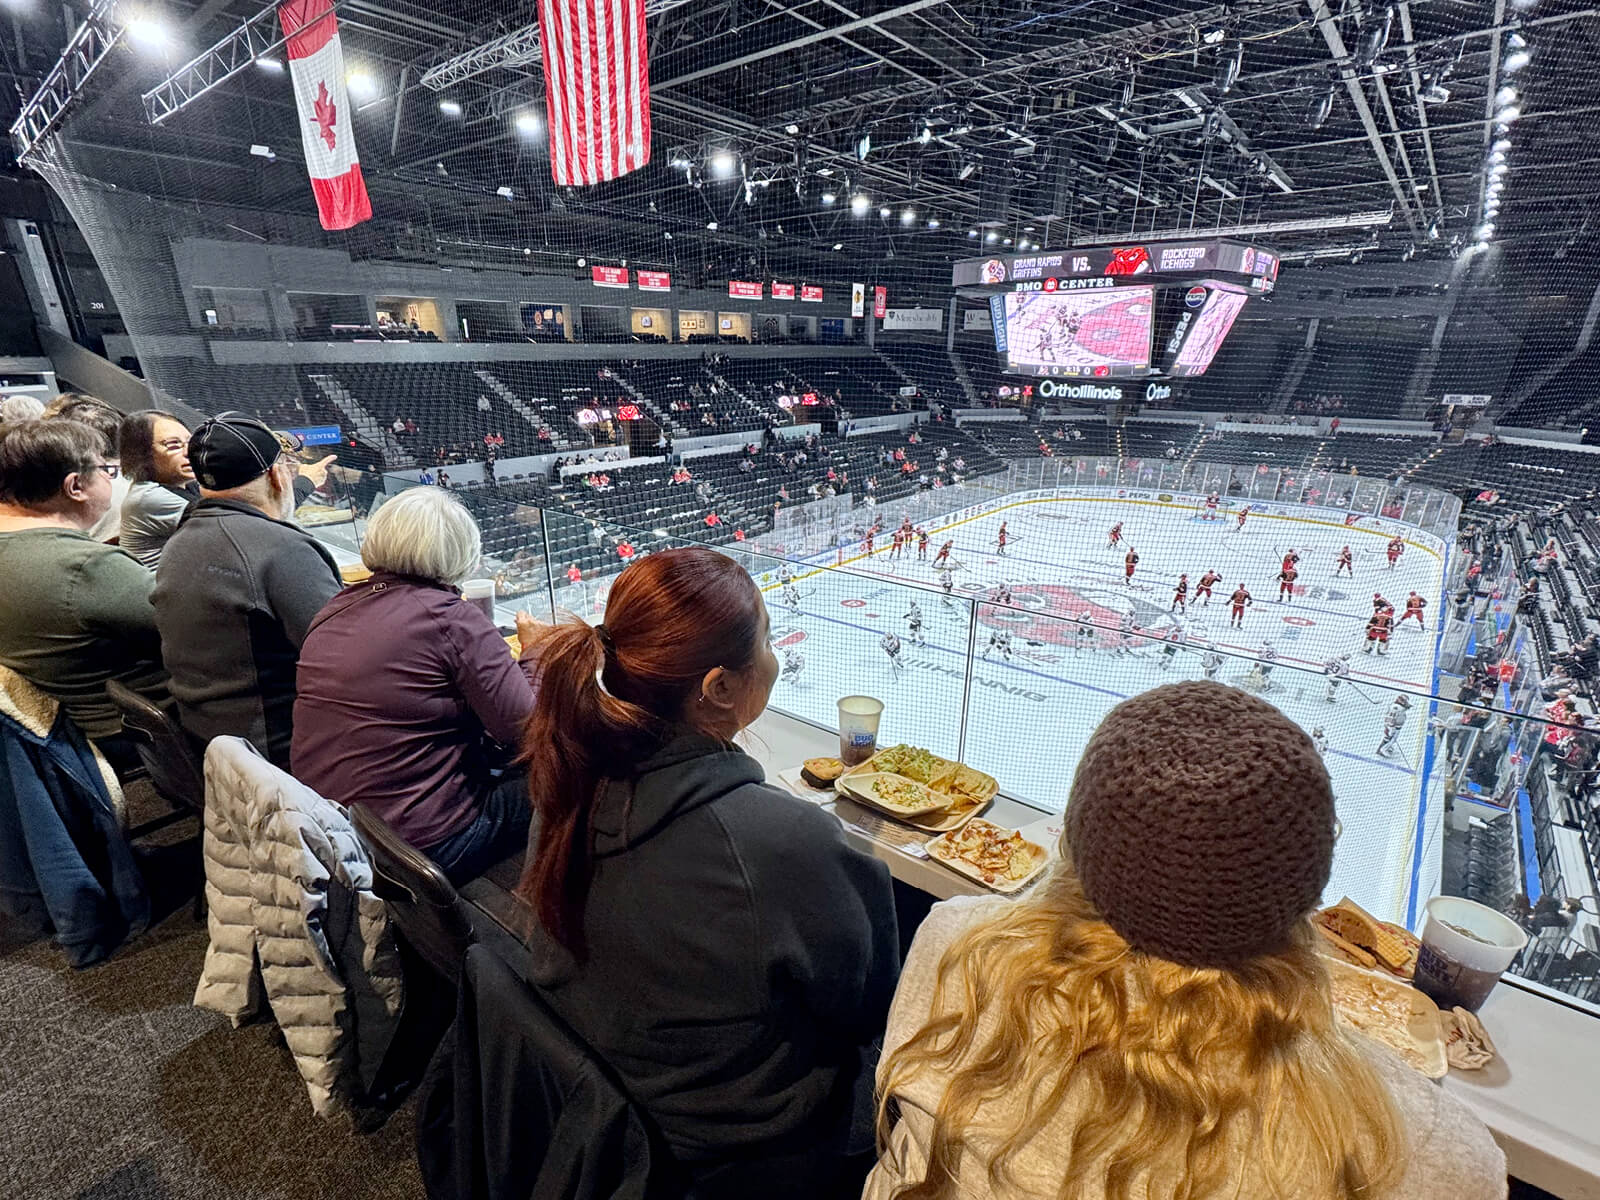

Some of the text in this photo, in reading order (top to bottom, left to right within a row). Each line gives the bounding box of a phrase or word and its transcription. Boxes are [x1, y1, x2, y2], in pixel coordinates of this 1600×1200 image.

[1163, 248, 1206, 258] ROCKFORD
[1013, 255, 1063, 269] GRAND RAPIDS
[1072, 257, 1092, 272] VS.
[1160, 258, 1195, 269] ICEHOGS
[1013, 267, 1042, 279] GRIFFINS
[1015, 277, 1114, 292] BMO CENTER
[90, 302, 105, 310] 201
[992, 298, 1007, 350] BUD LIGHT
[1167, 311, 1193, 354] PEPSI
[1039, 380, 1122, 401] OrthoIllinois
[306, 432, 338, 441] CENTER
[855, 734, 873, 742] BUD
